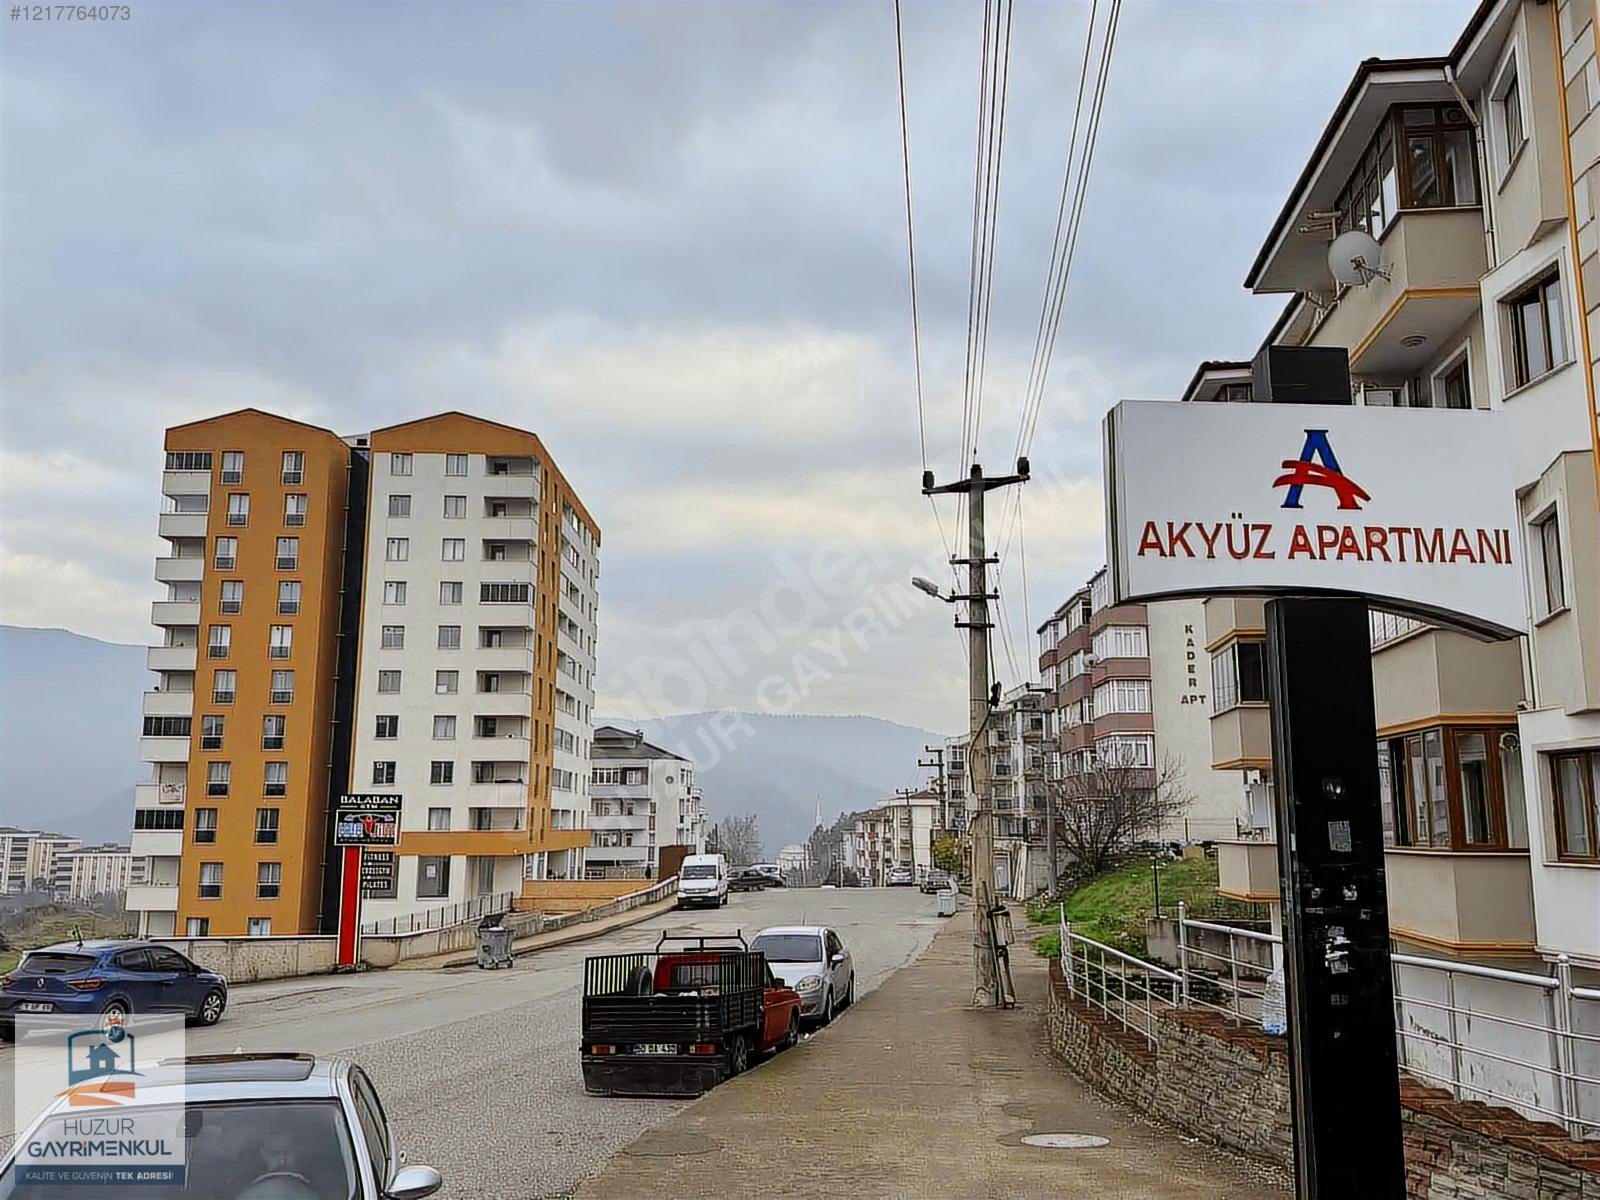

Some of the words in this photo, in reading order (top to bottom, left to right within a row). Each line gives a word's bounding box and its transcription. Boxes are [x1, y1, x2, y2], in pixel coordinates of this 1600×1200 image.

[1138, 512, 1276, 561] AKYÜZ
[1287, 524, 1513, 565] APARTMANI
[1184, 624, 1197, 687] KADER
[1181, 695, 1206, 705] APT
